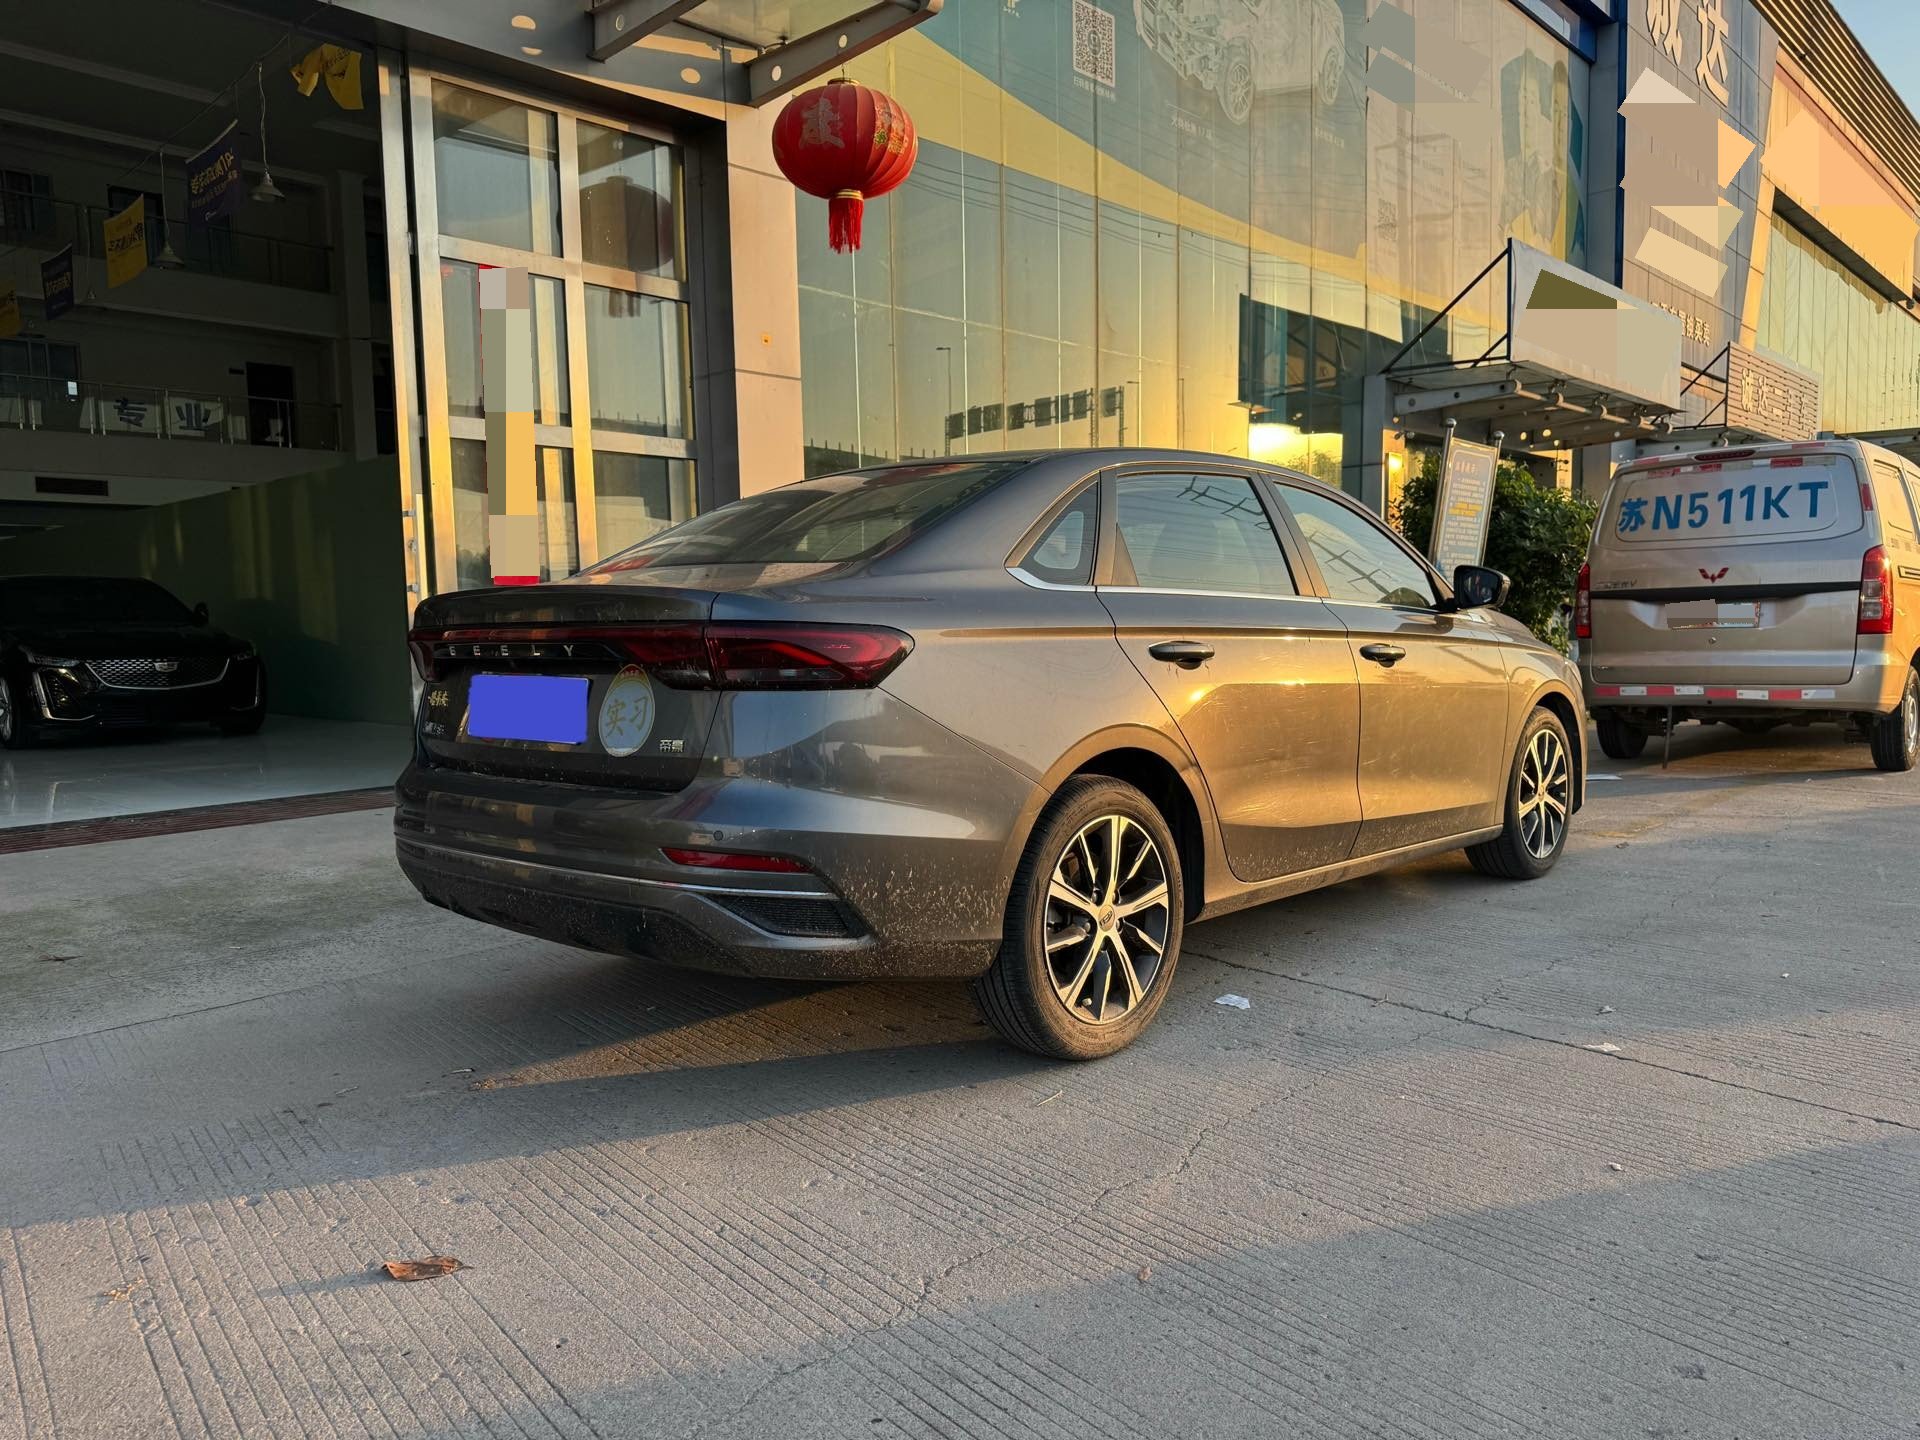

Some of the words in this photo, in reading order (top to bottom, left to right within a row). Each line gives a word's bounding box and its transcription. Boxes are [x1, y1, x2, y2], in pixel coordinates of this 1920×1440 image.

[1618, 481, 1828, 533] 苏N511KT
[448, 644, 575, 656] GEELY
[606, 696, 649, 737] 实习
